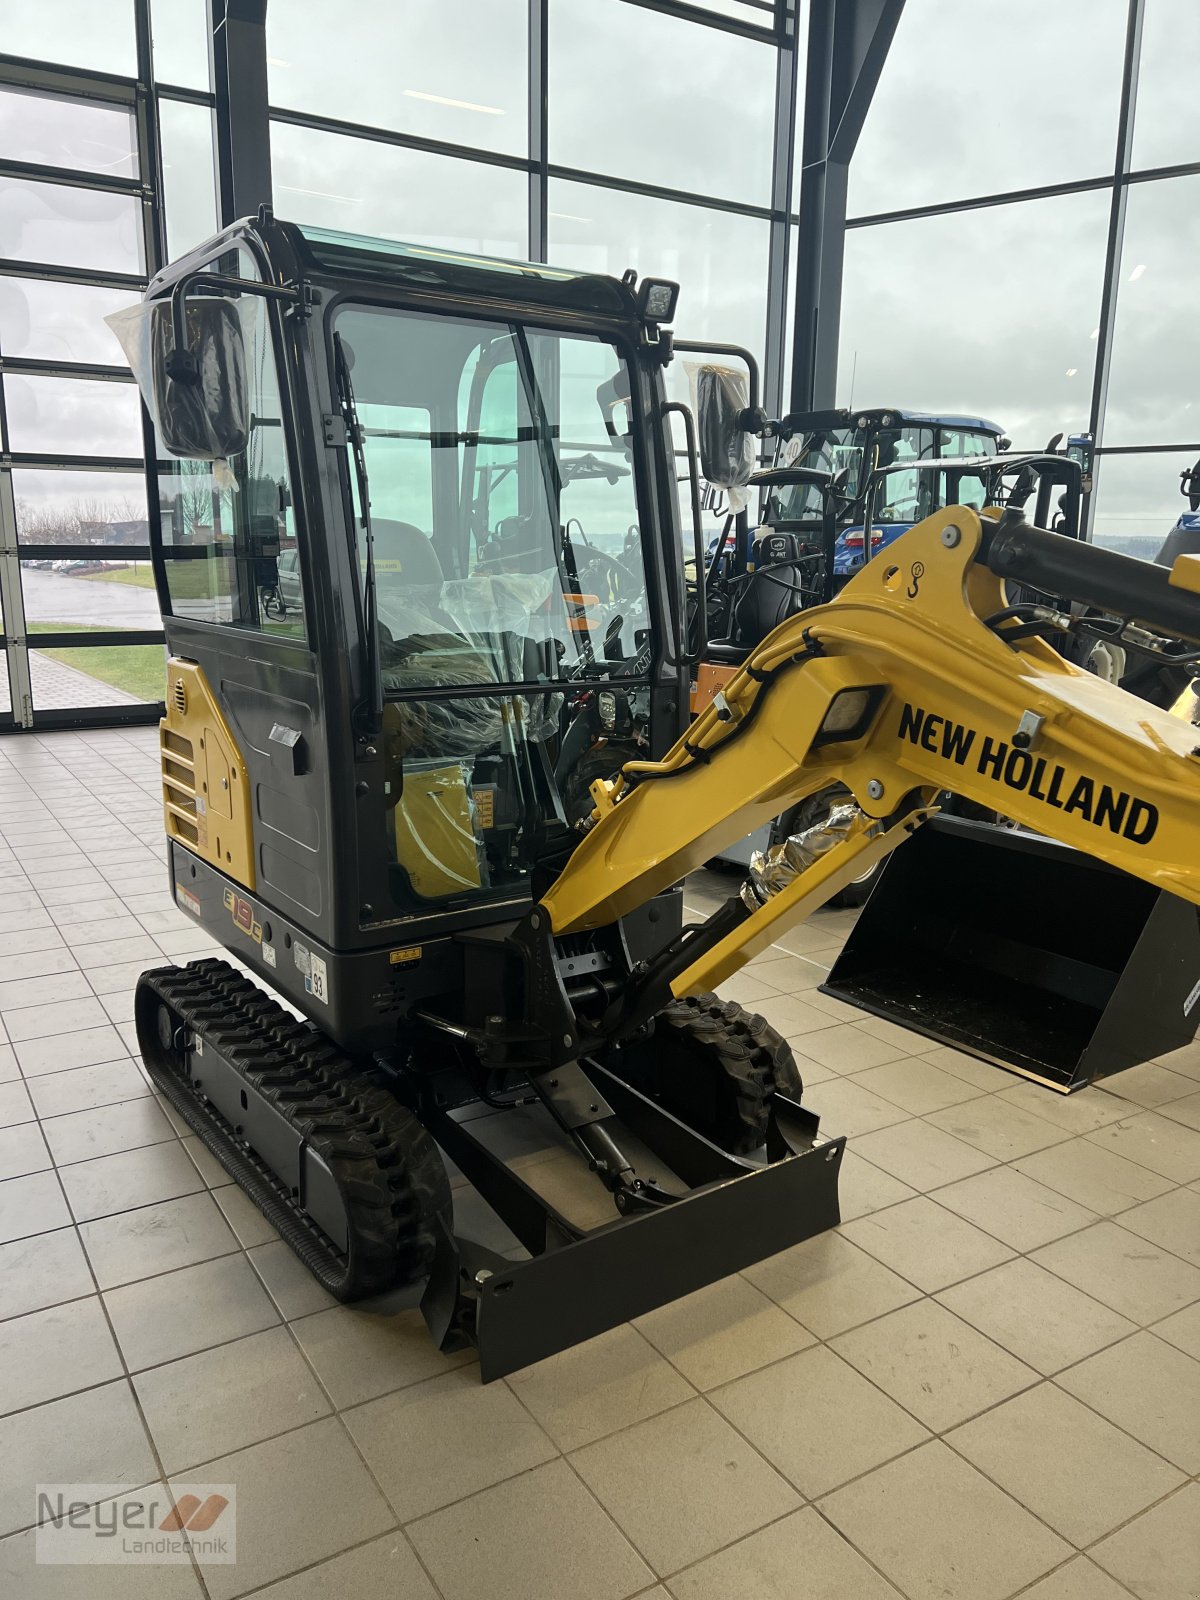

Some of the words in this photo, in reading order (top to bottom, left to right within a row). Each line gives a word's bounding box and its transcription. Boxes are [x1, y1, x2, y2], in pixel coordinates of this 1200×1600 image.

[786, 441, 799, 460] 40
[898, 703, 977, 766] NEW
[976, 736, 1159, 845] HOLLAND
[313, 972, 323, 997] 93
